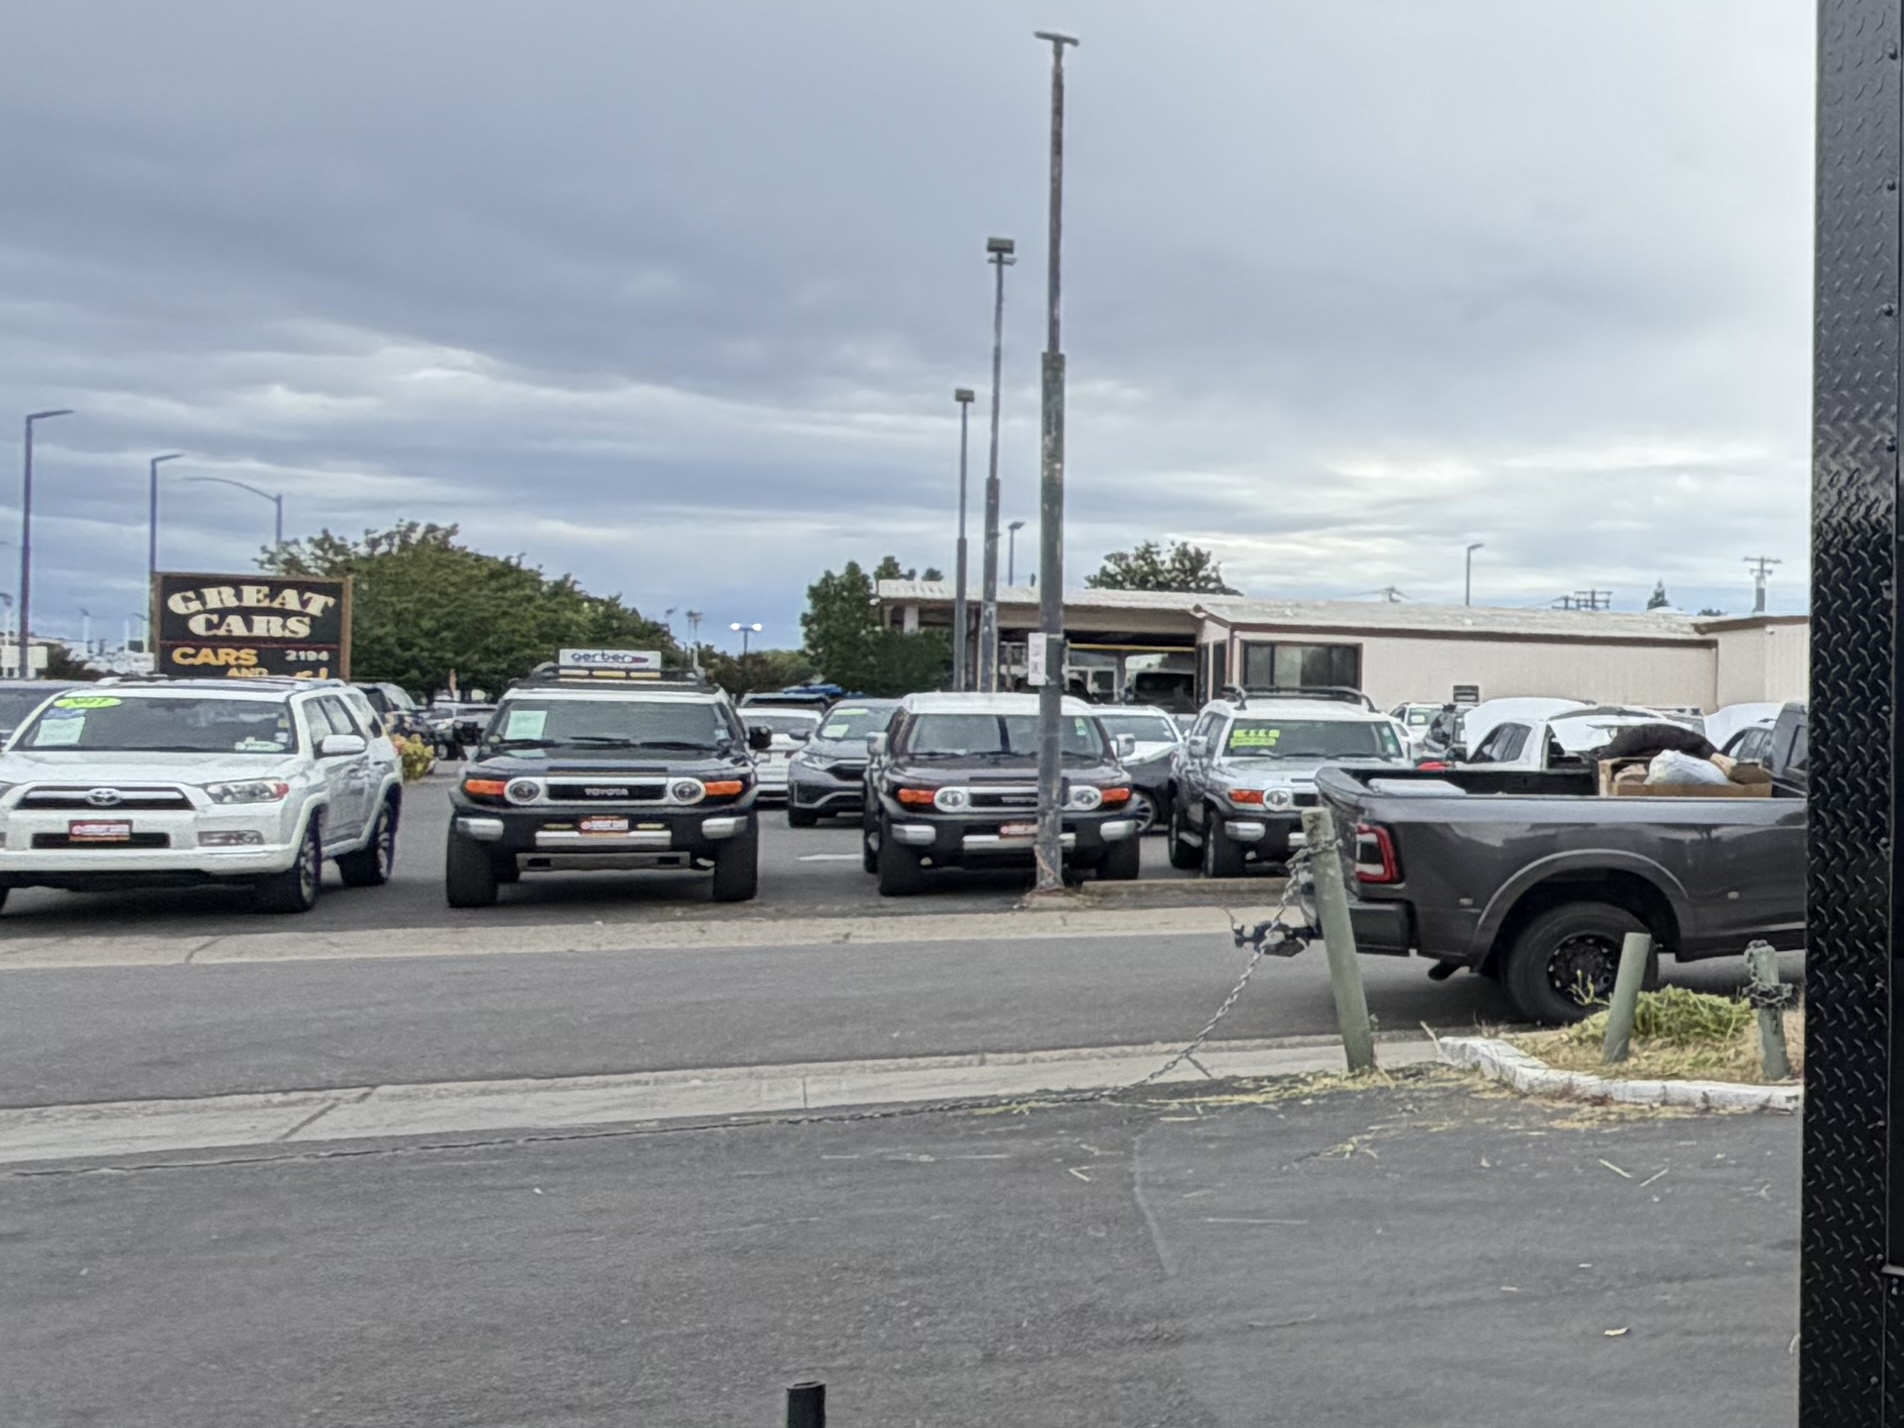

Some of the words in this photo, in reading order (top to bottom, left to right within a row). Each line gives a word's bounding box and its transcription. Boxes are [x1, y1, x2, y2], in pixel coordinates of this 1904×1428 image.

[167, 585, 336, 617] GREAT
[188, 613, 311, 638] CARS
[172, 647, 259, 666] CARS
[584, 788, 629, 796] TOYOTA
